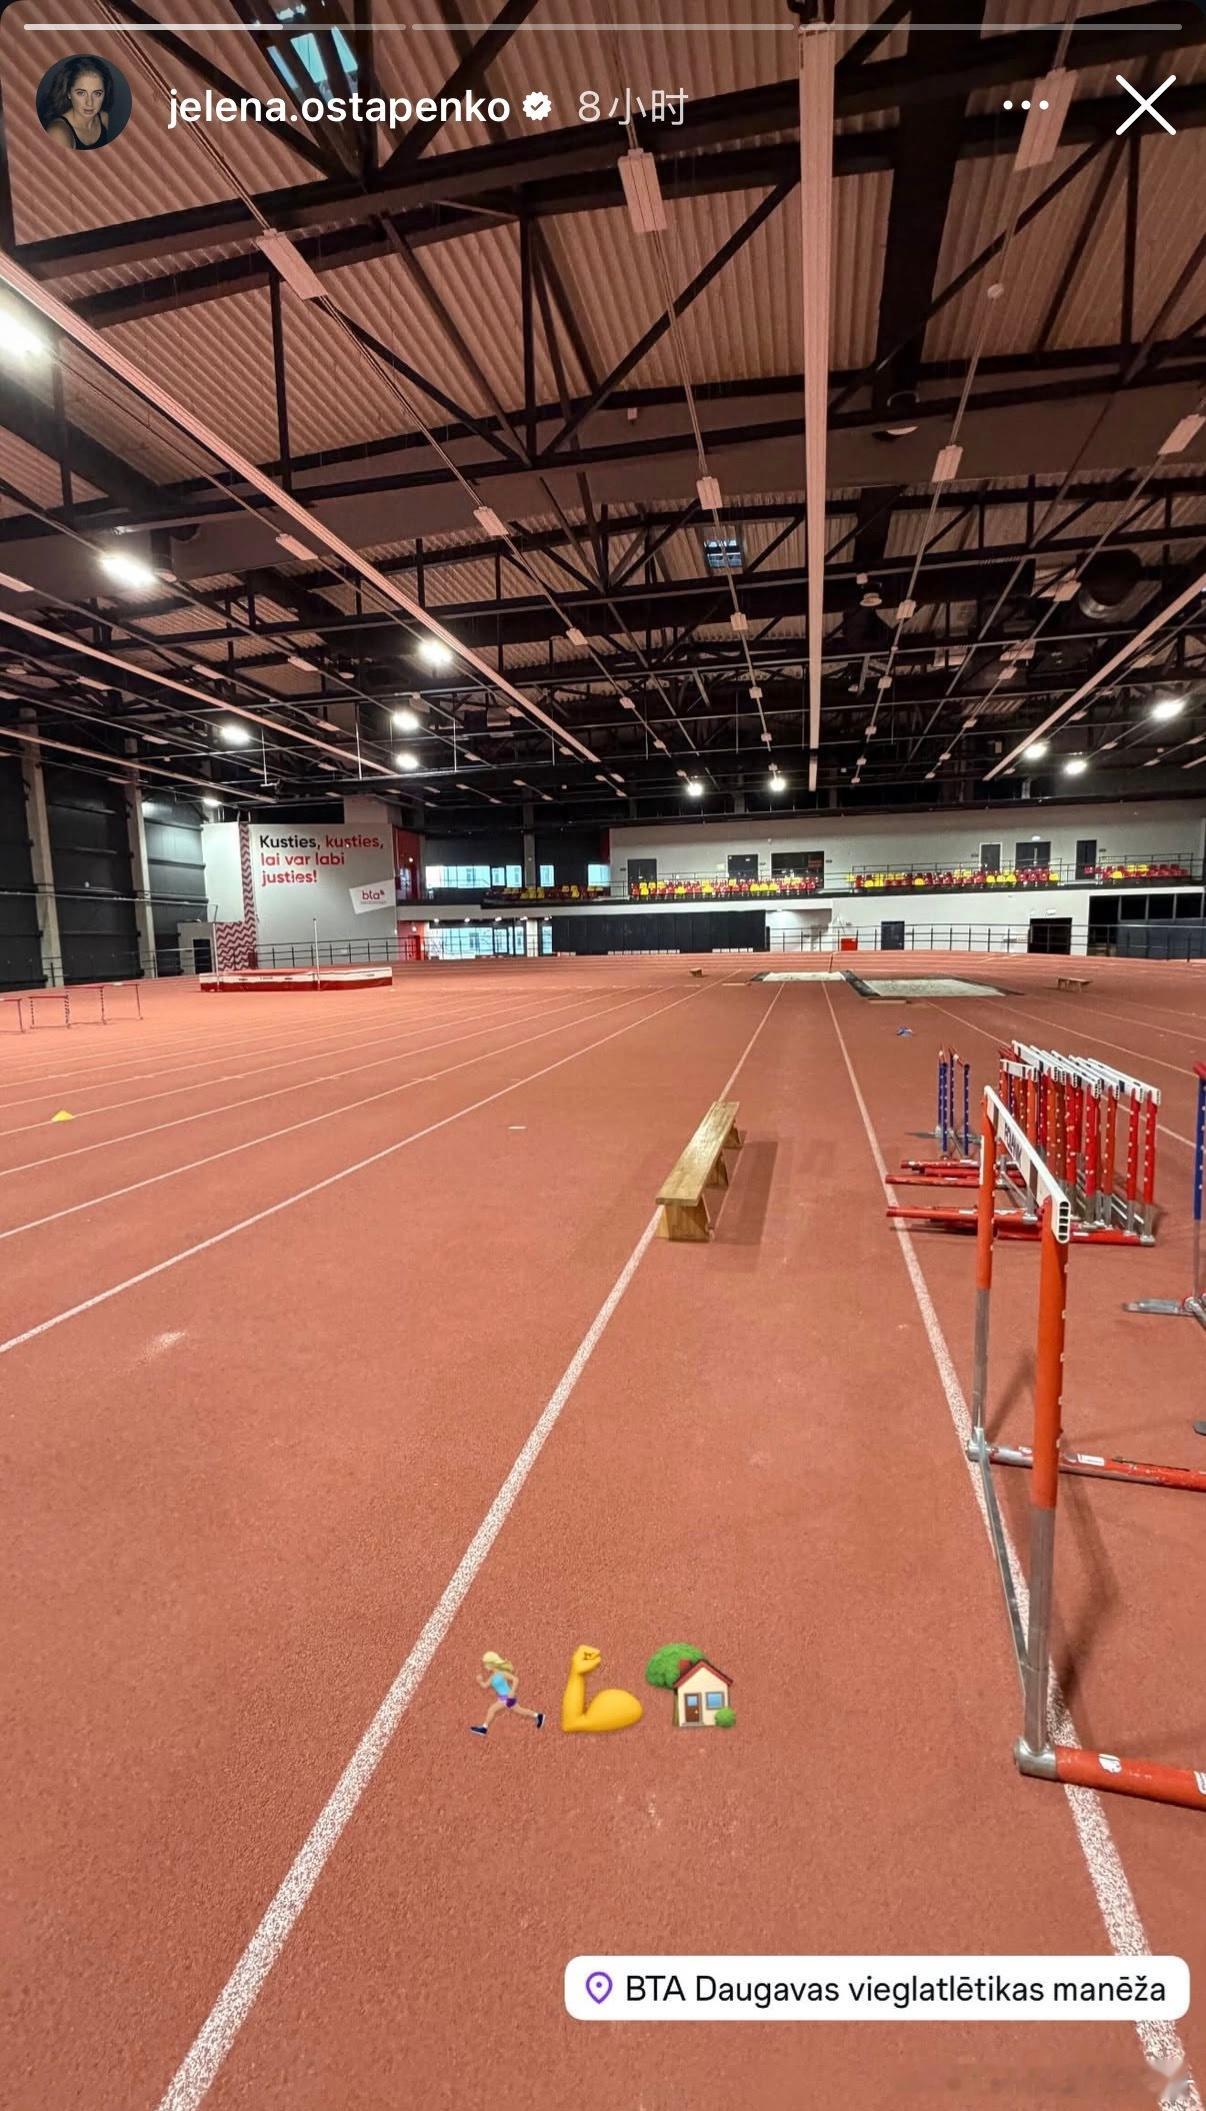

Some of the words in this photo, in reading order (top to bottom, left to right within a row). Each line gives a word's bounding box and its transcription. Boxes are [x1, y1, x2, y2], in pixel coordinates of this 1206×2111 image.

[259, 835, 321, 850] Kusties,
[325, 835, 384, 849] kusties,
[261, 853, 280, 866] lai
[285, 856, 311, 866] var
[315, 852, 345, 865] labi
[262, 870, 317, 887] justies!
